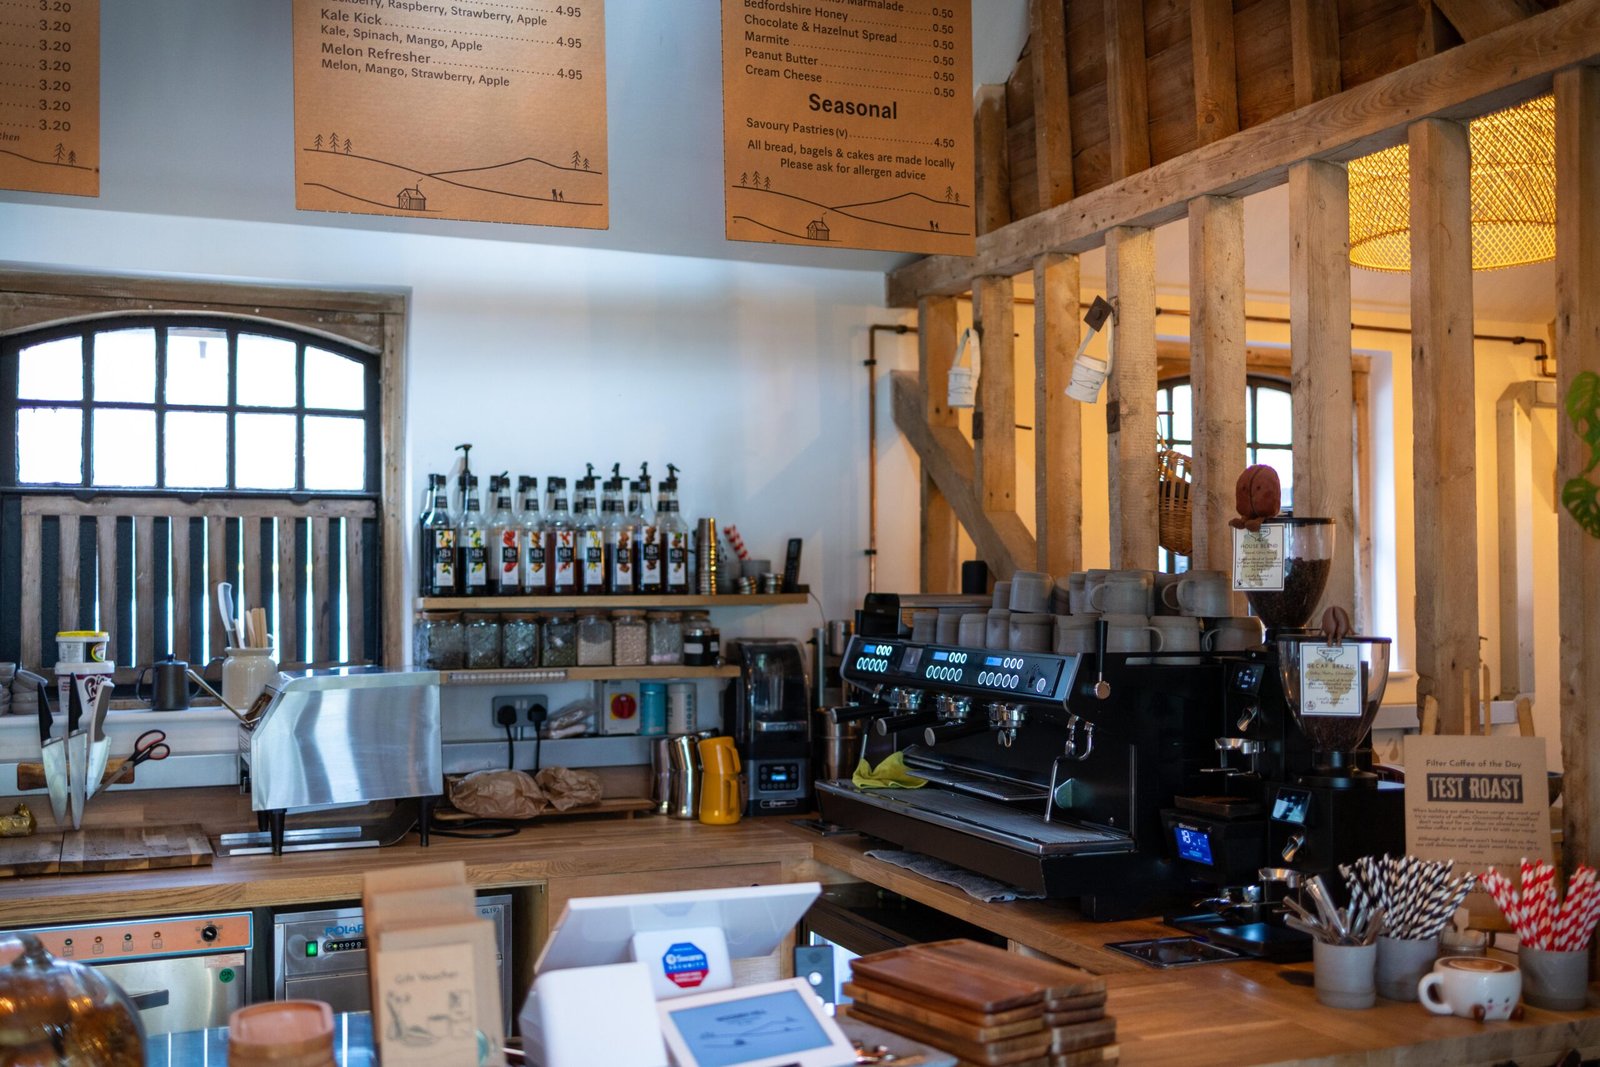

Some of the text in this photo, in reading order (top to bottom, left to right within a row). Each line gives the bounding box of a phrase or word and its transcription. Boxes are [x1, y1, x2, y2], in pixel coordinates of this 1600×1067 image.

[39, 0, 71, 13] 3.20
[389, 0, 447, 16] Raspberry,
[451, 6, 514, 24] Strawberry,
[517, 12, 547, 27] Apple
[555, 6, 581, 18] 4.95
[744, 0, 954, 34] Bedfordshire Honey 0.50
[932, 8, 954, 19] 0.50
[39, 20, 71, 33] 3.20
[321, 9, 582, 49] Kale Kick 4.95
[321, 25, 482, 52] Kale, Spinach, Mango, Apple
[744, 15, 954, 50] Chocolate & Hazelnut Spread 0.50
[39, 40, 71, 53] 3.20
[745, 32, 954, 66] Marmite 0.50
[39, 60, 71, 73] 3.20
[321, 42, 582, 80] Melon Refresher 4.95
[321, 59, 510, 87] Melon, Mango, Strawberry, Apple
[745, 48, 954, 82] Peanut Butter 0.50
[39, 79, 71, 92] 3.20
[746, 65, 955, 98] Cream Cheese 0.50
[39, 99, 71, 112] 3.20
[809, 93, 897, 119] Seasonal
[39, 119, 71, 132] 3.20
[746, 118, 789, 133] Savoury
[793, 123, 834, 136] Pastries
[934, 138, 955, 148] 4.50
[748, 140, 955, 170] All bread, bagels & cakes are made locally
[781, 158, 926, 180] Please ask for allergen advice
[1430, 777, 1520, 800] TEST ROAST
